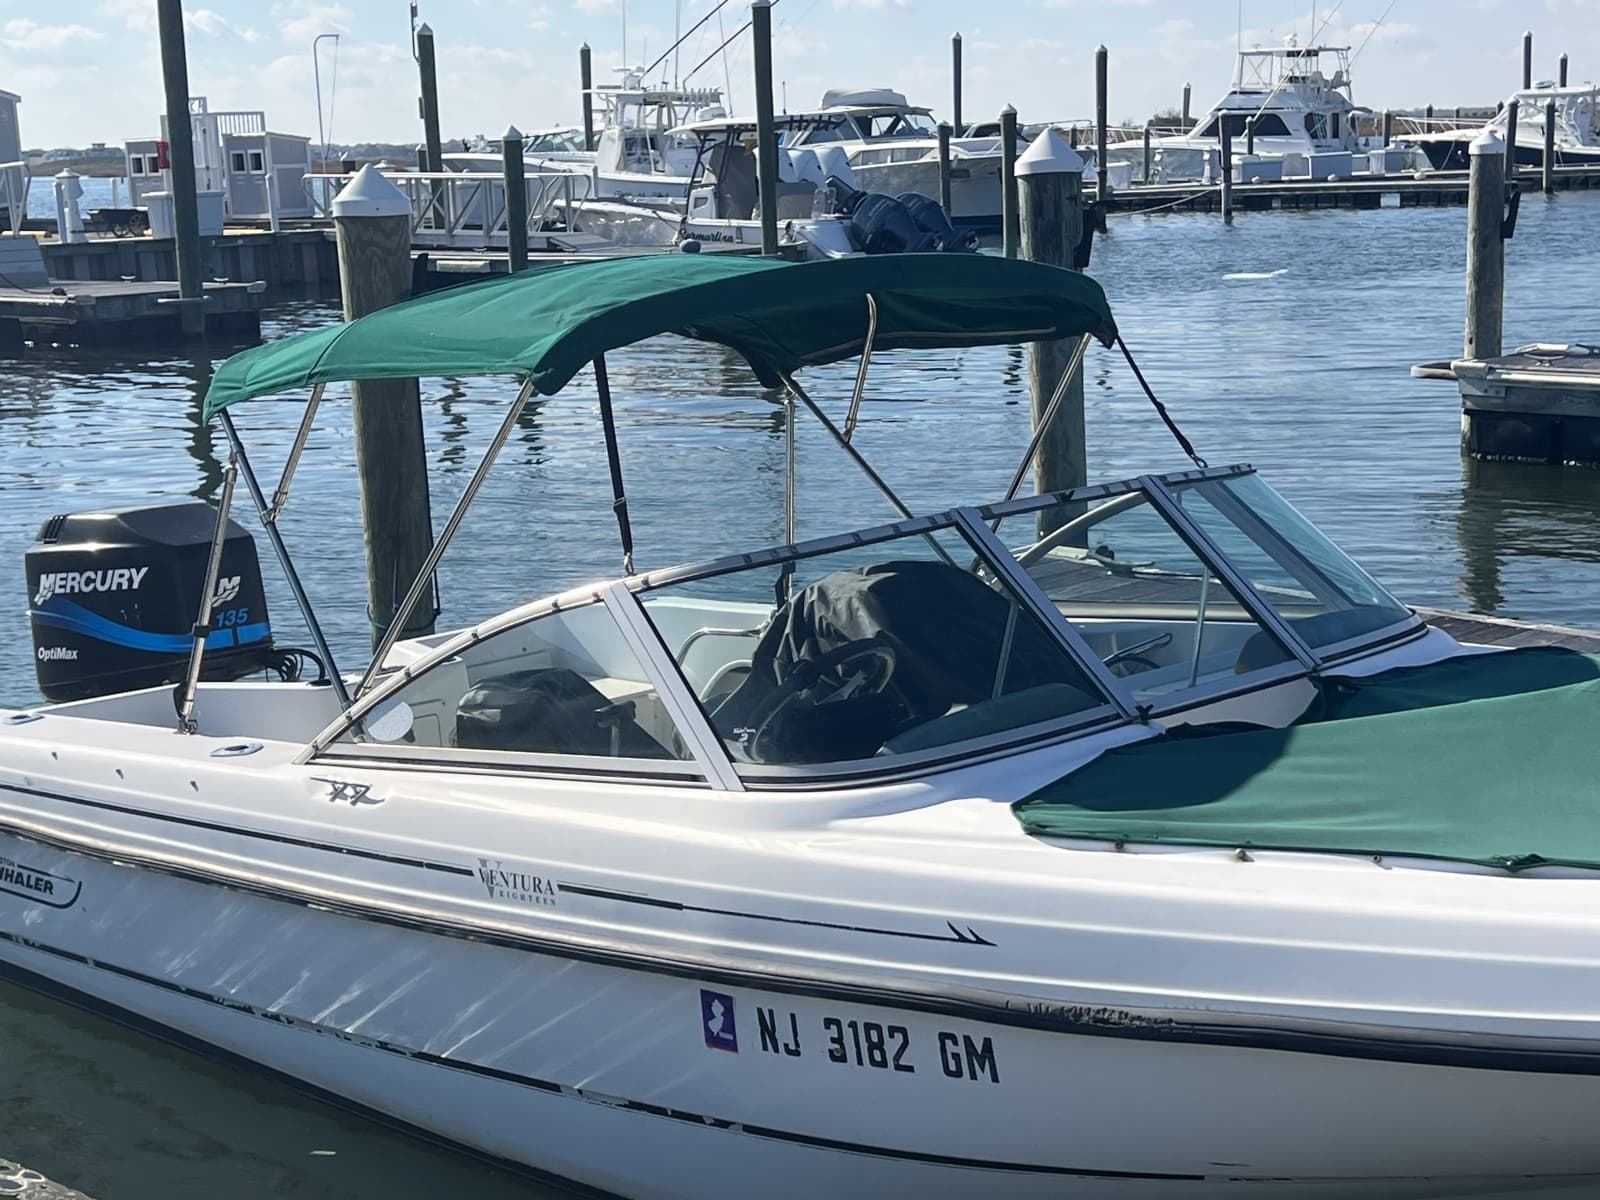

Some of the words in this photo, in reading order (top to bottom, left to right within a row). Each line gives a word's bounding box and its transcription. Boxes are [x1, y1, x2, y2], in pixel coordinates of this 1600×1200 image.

[34, 566, 149, 605] MERCURY
[215, 607, 249, 628] 135
[38, 646, 78, 661] OptiMax
[477, 857, 555, 899] VENTURA
[499, 889, 556, 906] EIGHTEEN
[756, 1006, 801, 1057] NJ
[823, 1016, 915, 1073] 3182
[937, 1031, 1000, 1083] GM
